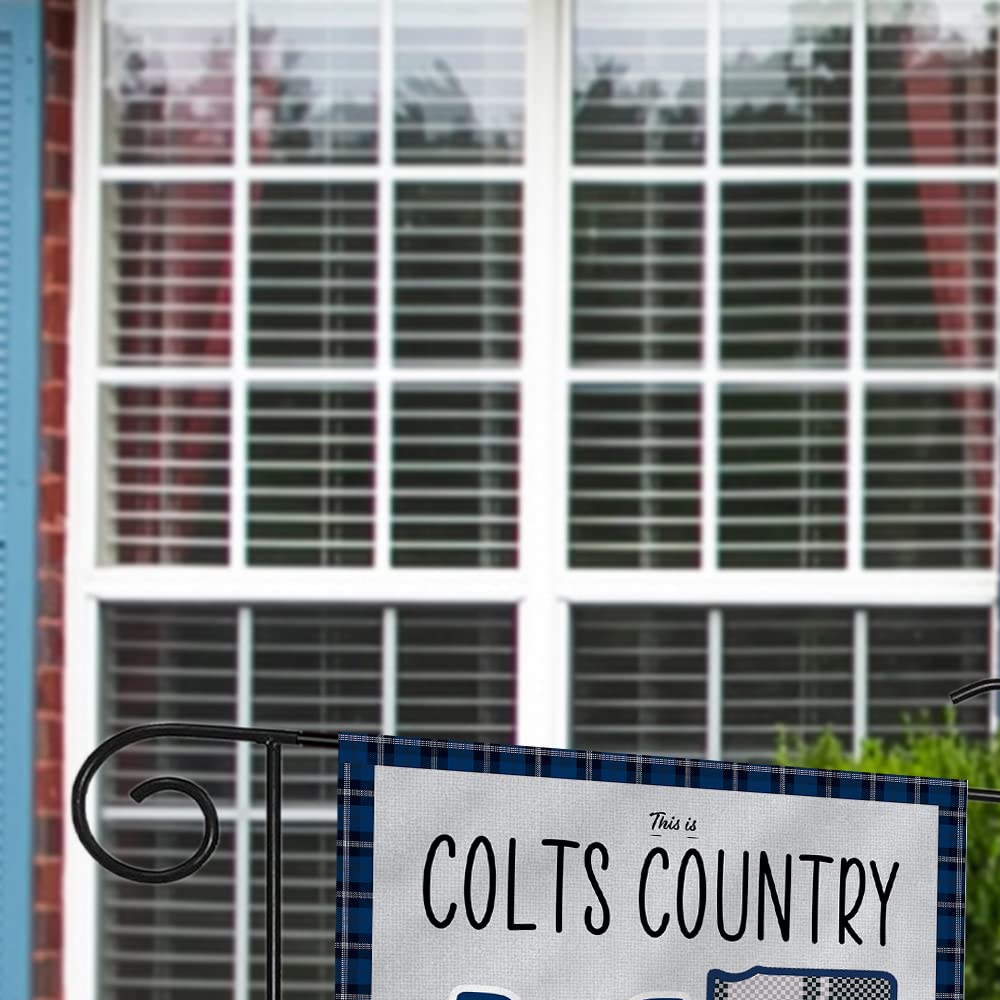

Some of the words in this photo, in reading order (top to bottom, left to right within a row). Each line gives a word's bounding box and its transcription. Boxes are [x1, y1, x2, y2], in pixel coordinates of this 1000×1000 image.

[649, 811, 680, 831] This
[685, 816, 697, 832] is
[422, 833, 611, 936] COLTS
[638, 846, 900, 946] COUNTRY
